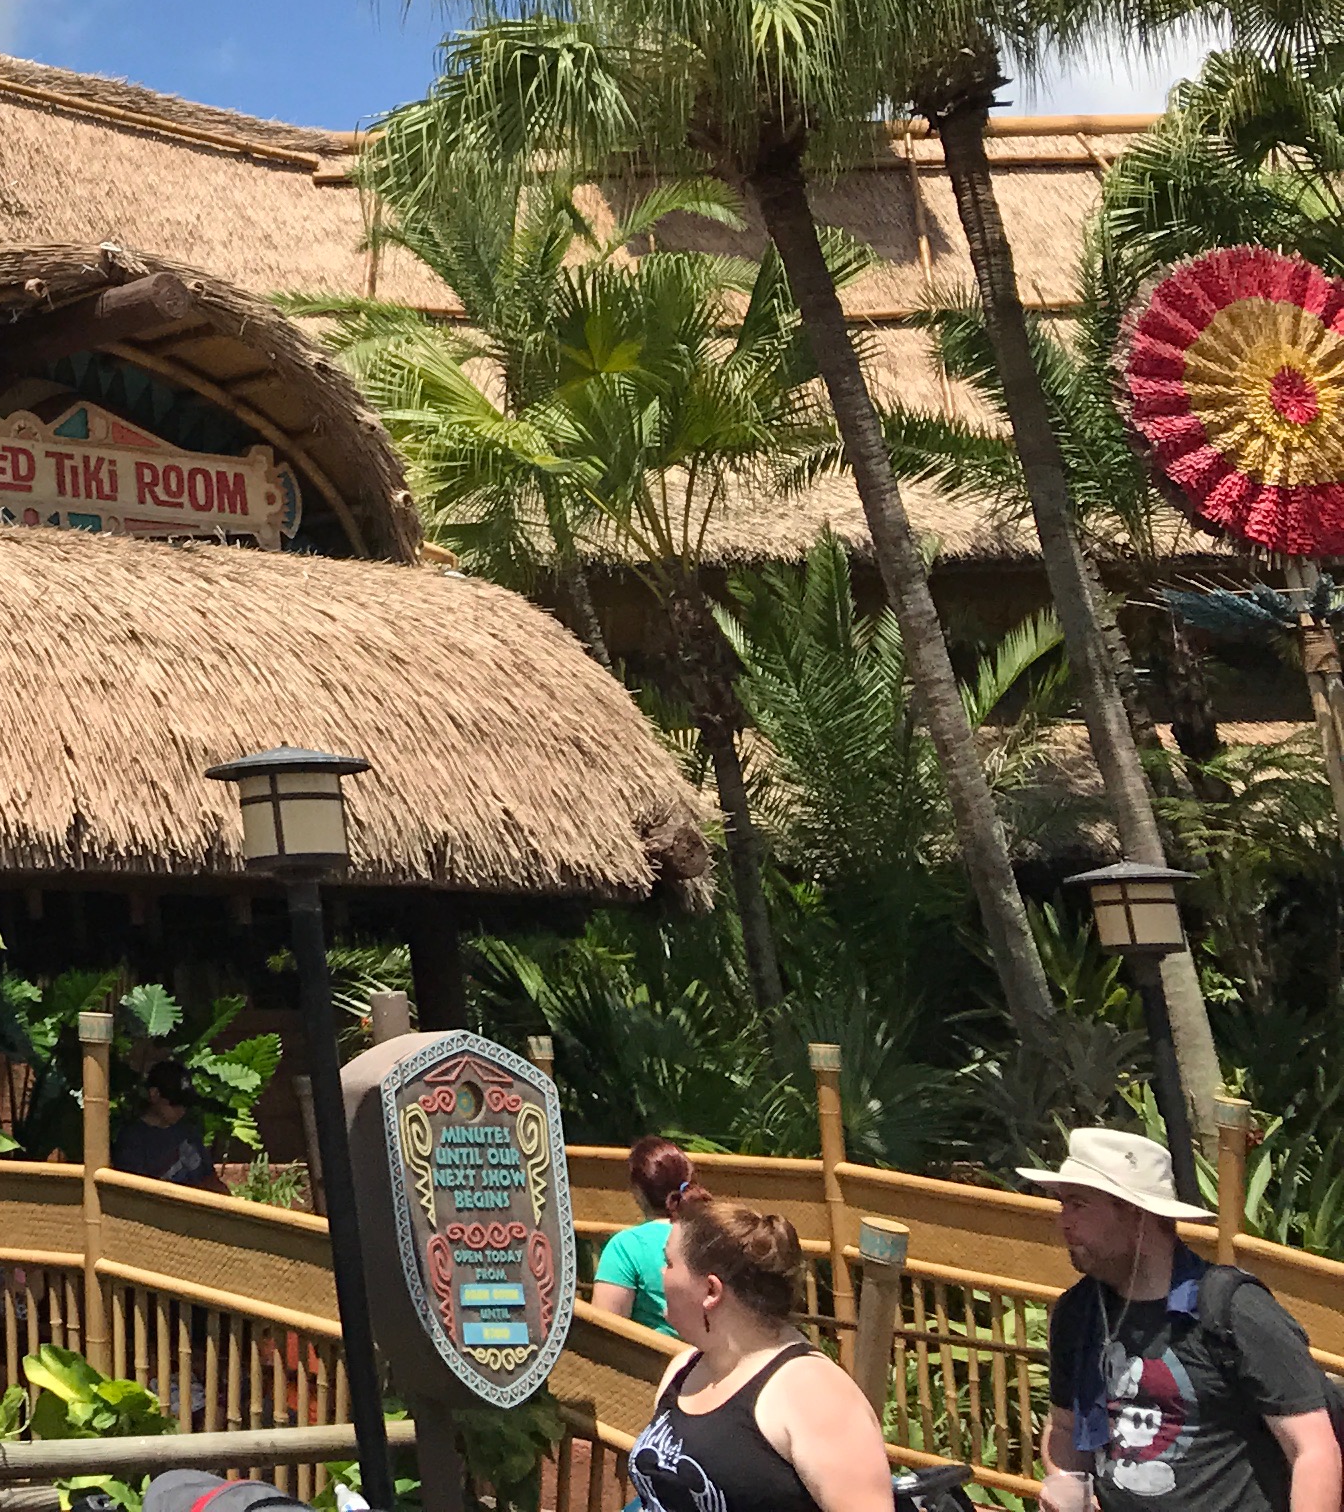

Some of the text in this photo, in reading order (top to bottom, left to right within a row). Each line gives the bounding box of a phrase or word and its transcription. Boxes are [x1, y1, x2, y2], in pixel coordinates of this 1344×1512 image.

[45, 451, 119, 502] TIKI
[134, 461, 250, 516] ROOM
[440, 1126, 511, 1144] MINUTES
[435, 1147, 520, 1165] UNTIL OUR
[432, 1168, 526, 1187] NEXT SHOW
[454, 1189, 510, 1208] BEGINS
[453, 1249, 523, 1263] OPEN TODAY
[475, 1267, 507, 1280] FROM
[480, 1308, 511, 1319] UNTIL
